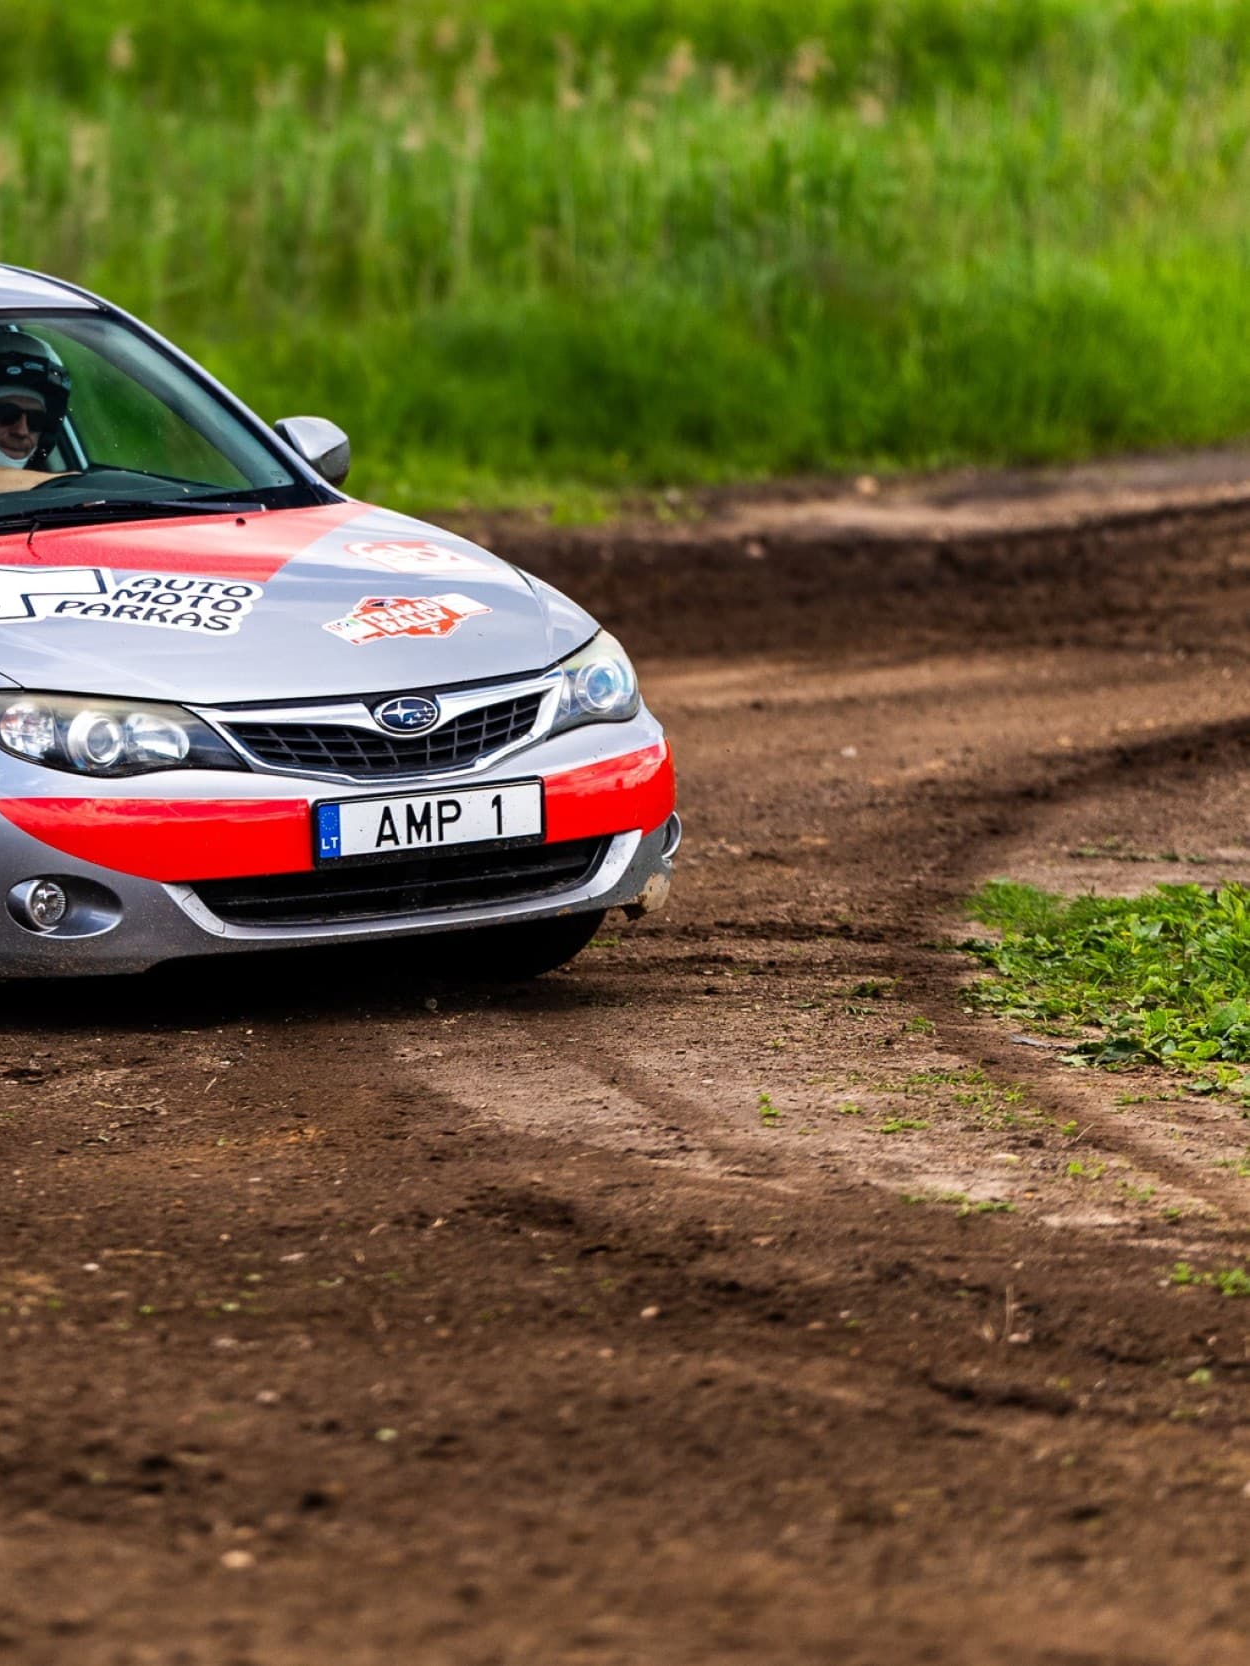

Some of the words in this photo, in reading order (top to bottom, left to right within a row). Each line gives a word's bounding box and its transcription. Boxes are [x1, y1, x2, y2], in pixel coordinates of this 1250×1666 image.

[132, 577, 253, 598] AUTO
[112, 588, 242, 613] MOTO
[54, 600, 232, 631] PARKAS
[376, 608, 449, 632] RALLY
[375, 799, 462, 847] AMP
[491, 794, 502, 835] 1
[321, 836, 338, 850] LT
